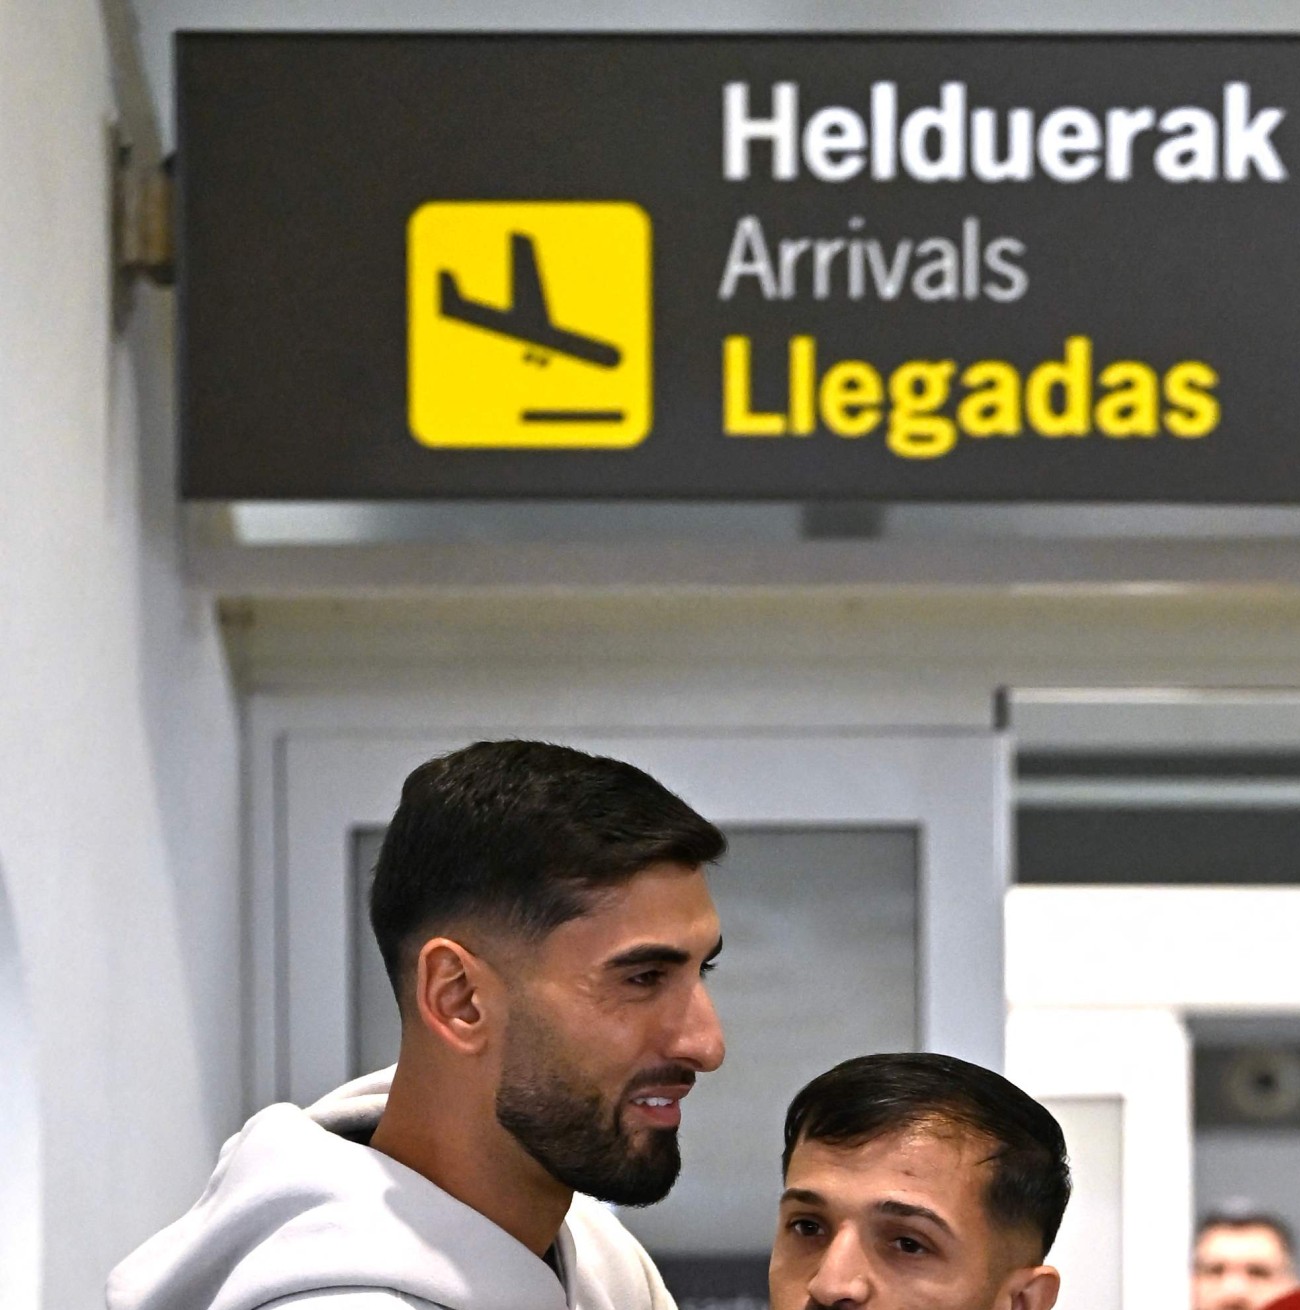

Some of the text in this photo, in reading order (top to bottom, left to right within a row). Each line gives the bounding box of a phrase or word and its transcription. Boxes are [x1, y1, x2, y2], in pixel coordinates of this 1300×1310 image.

[722, 81, 1287, 182] Helduerak
[719, 215, 1028, 302] Arrivals
[722, 335, 1219, 459] Llegadas
